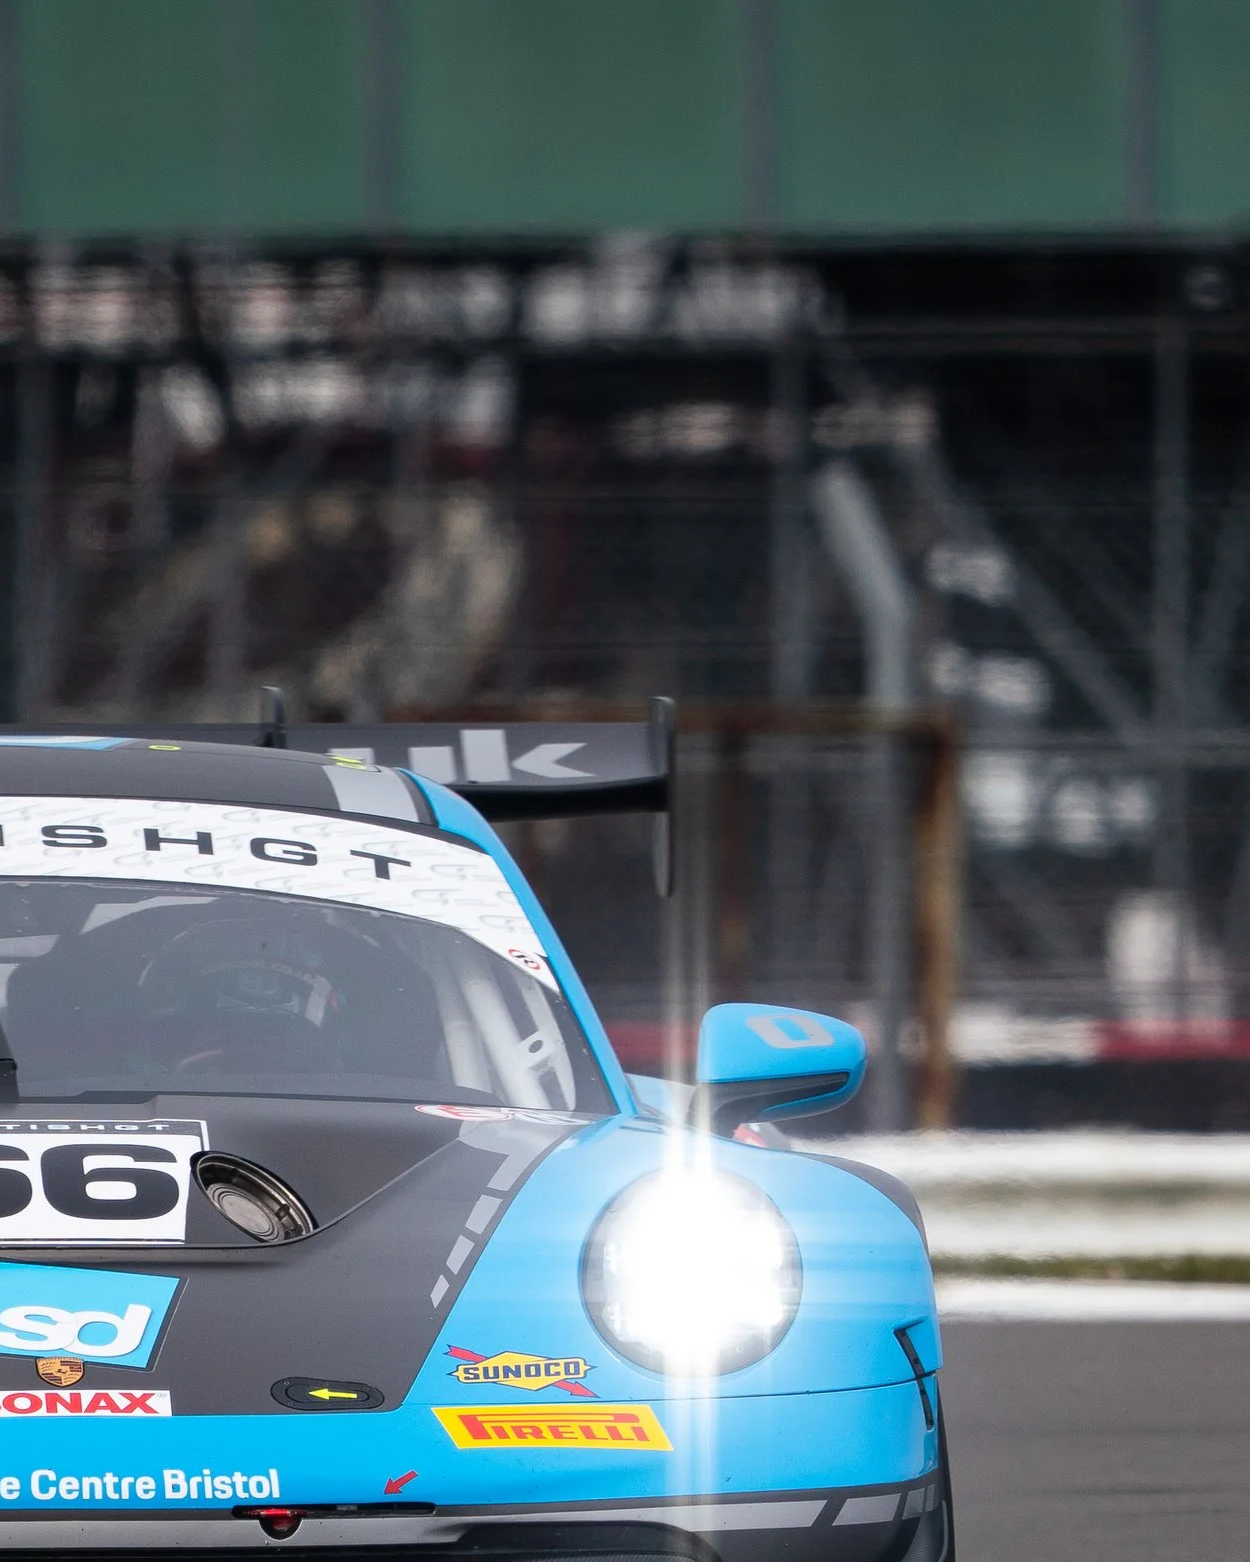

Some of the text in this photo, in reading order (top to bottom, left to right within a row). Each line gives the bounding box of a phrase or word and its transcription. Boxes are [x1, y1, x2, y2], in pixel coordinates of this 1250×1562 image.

[463, 1361, 581, 1381] SUNOCO
[457, 1413, 650, 1441] PIRELLI
[30, 1470, 156, 1499] Centre
[163, 1469, 280, 1499] Bristol
